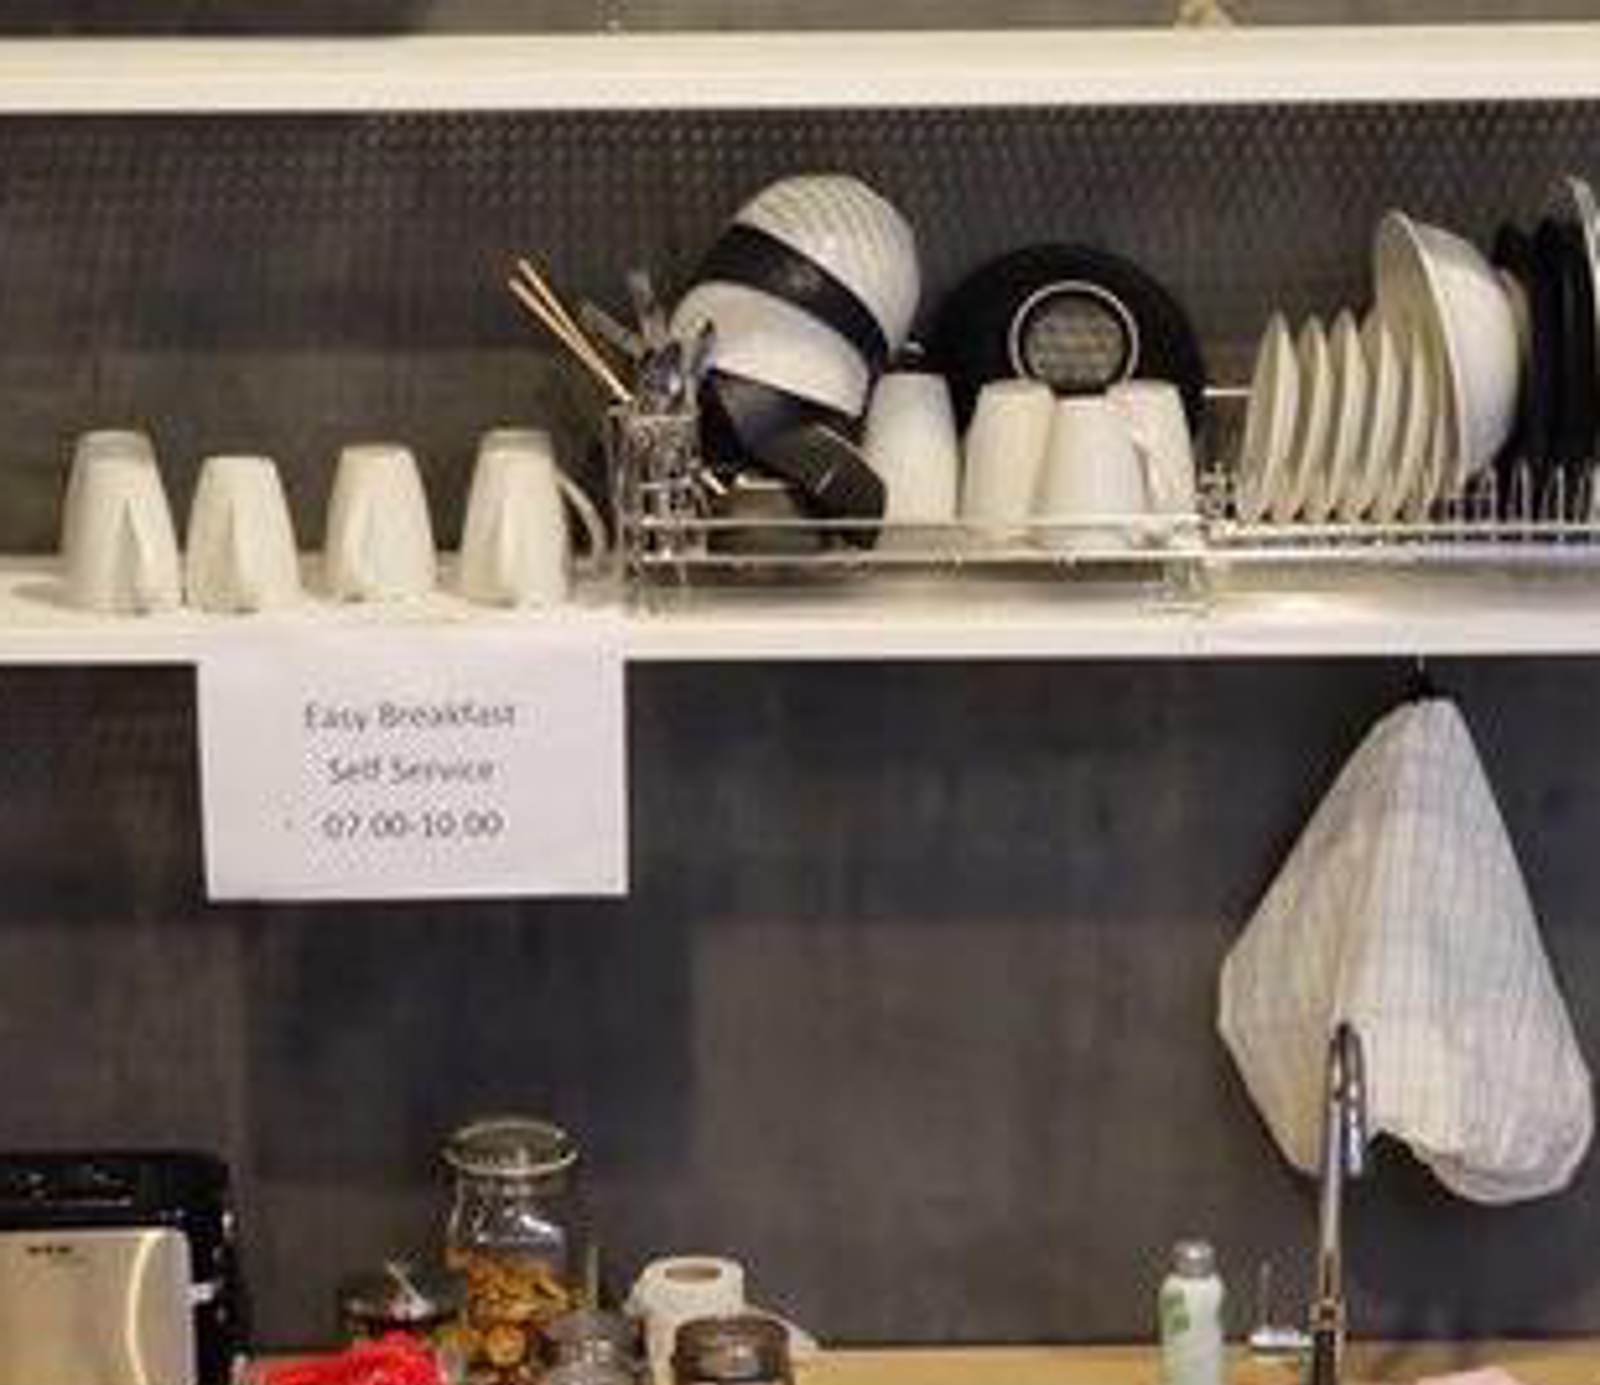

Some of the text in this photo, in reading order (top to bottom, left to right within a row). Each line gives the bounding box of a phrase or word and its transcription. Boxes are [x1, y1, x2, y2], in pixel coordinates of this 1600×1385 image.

[305, 702, 516, 732] Easy Breakfast
[329, 758, 494, 784] Self Service
